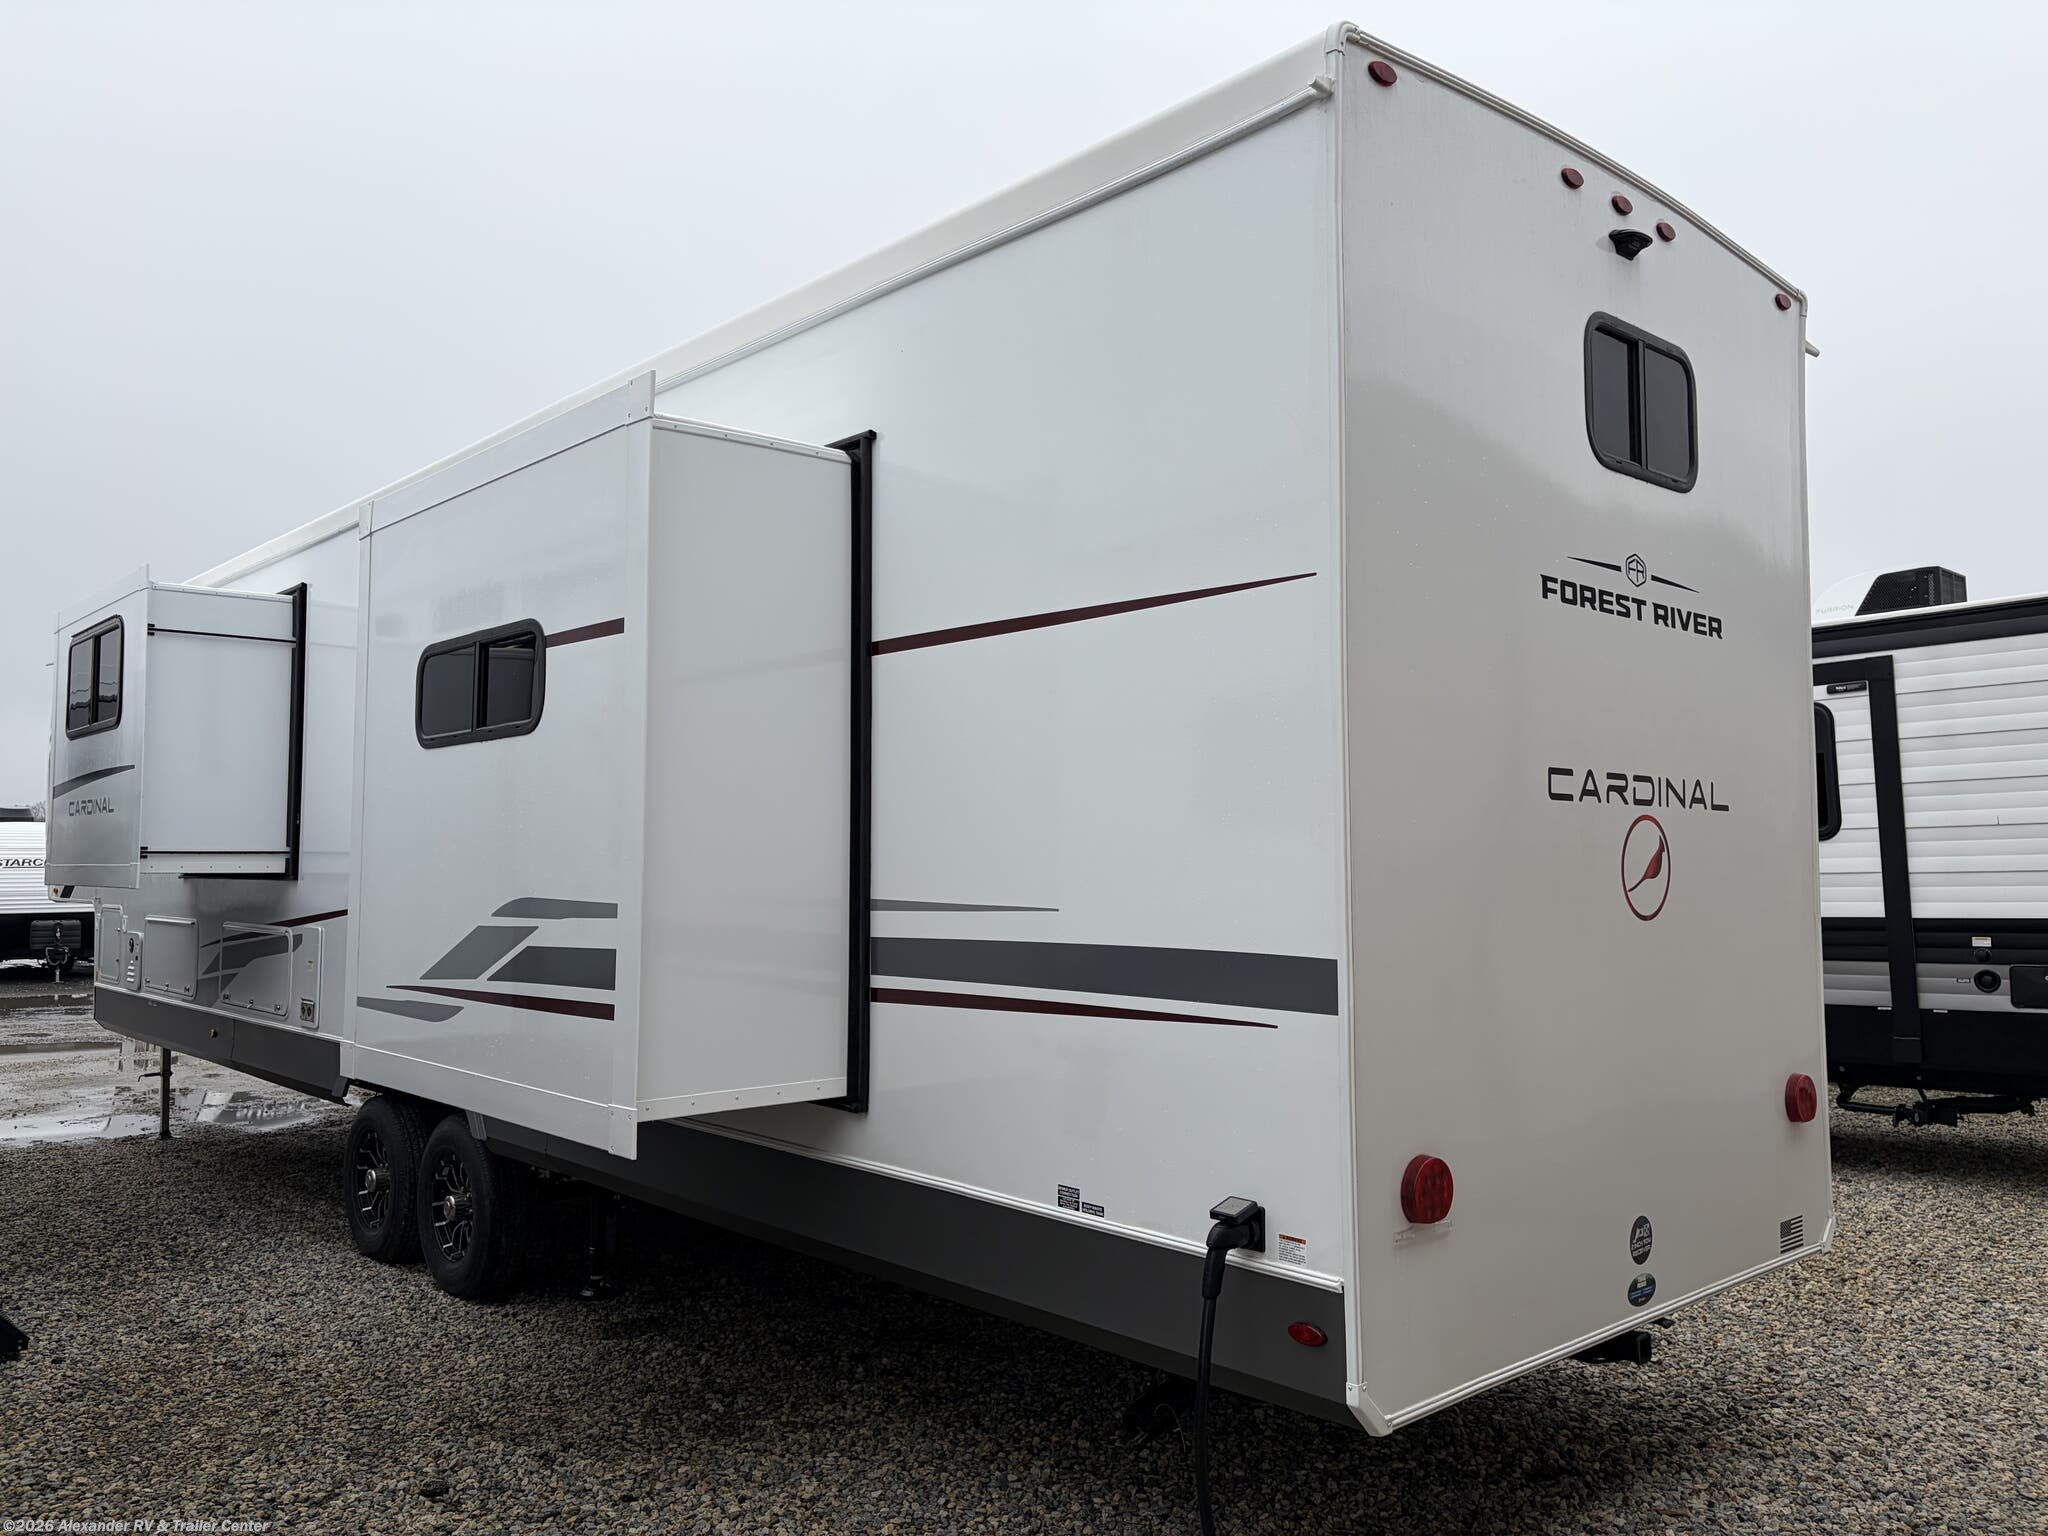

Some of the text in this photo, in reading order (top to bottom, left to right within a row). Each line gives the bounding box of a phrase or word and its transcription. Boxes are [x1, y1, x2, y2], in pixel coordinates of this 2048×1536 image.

[1540, 574, 1723, 639] FOREST RIVER
[69, 796, 115, 816] CARDINAL
[1548, 767, 1730, 811] CARDINAL
